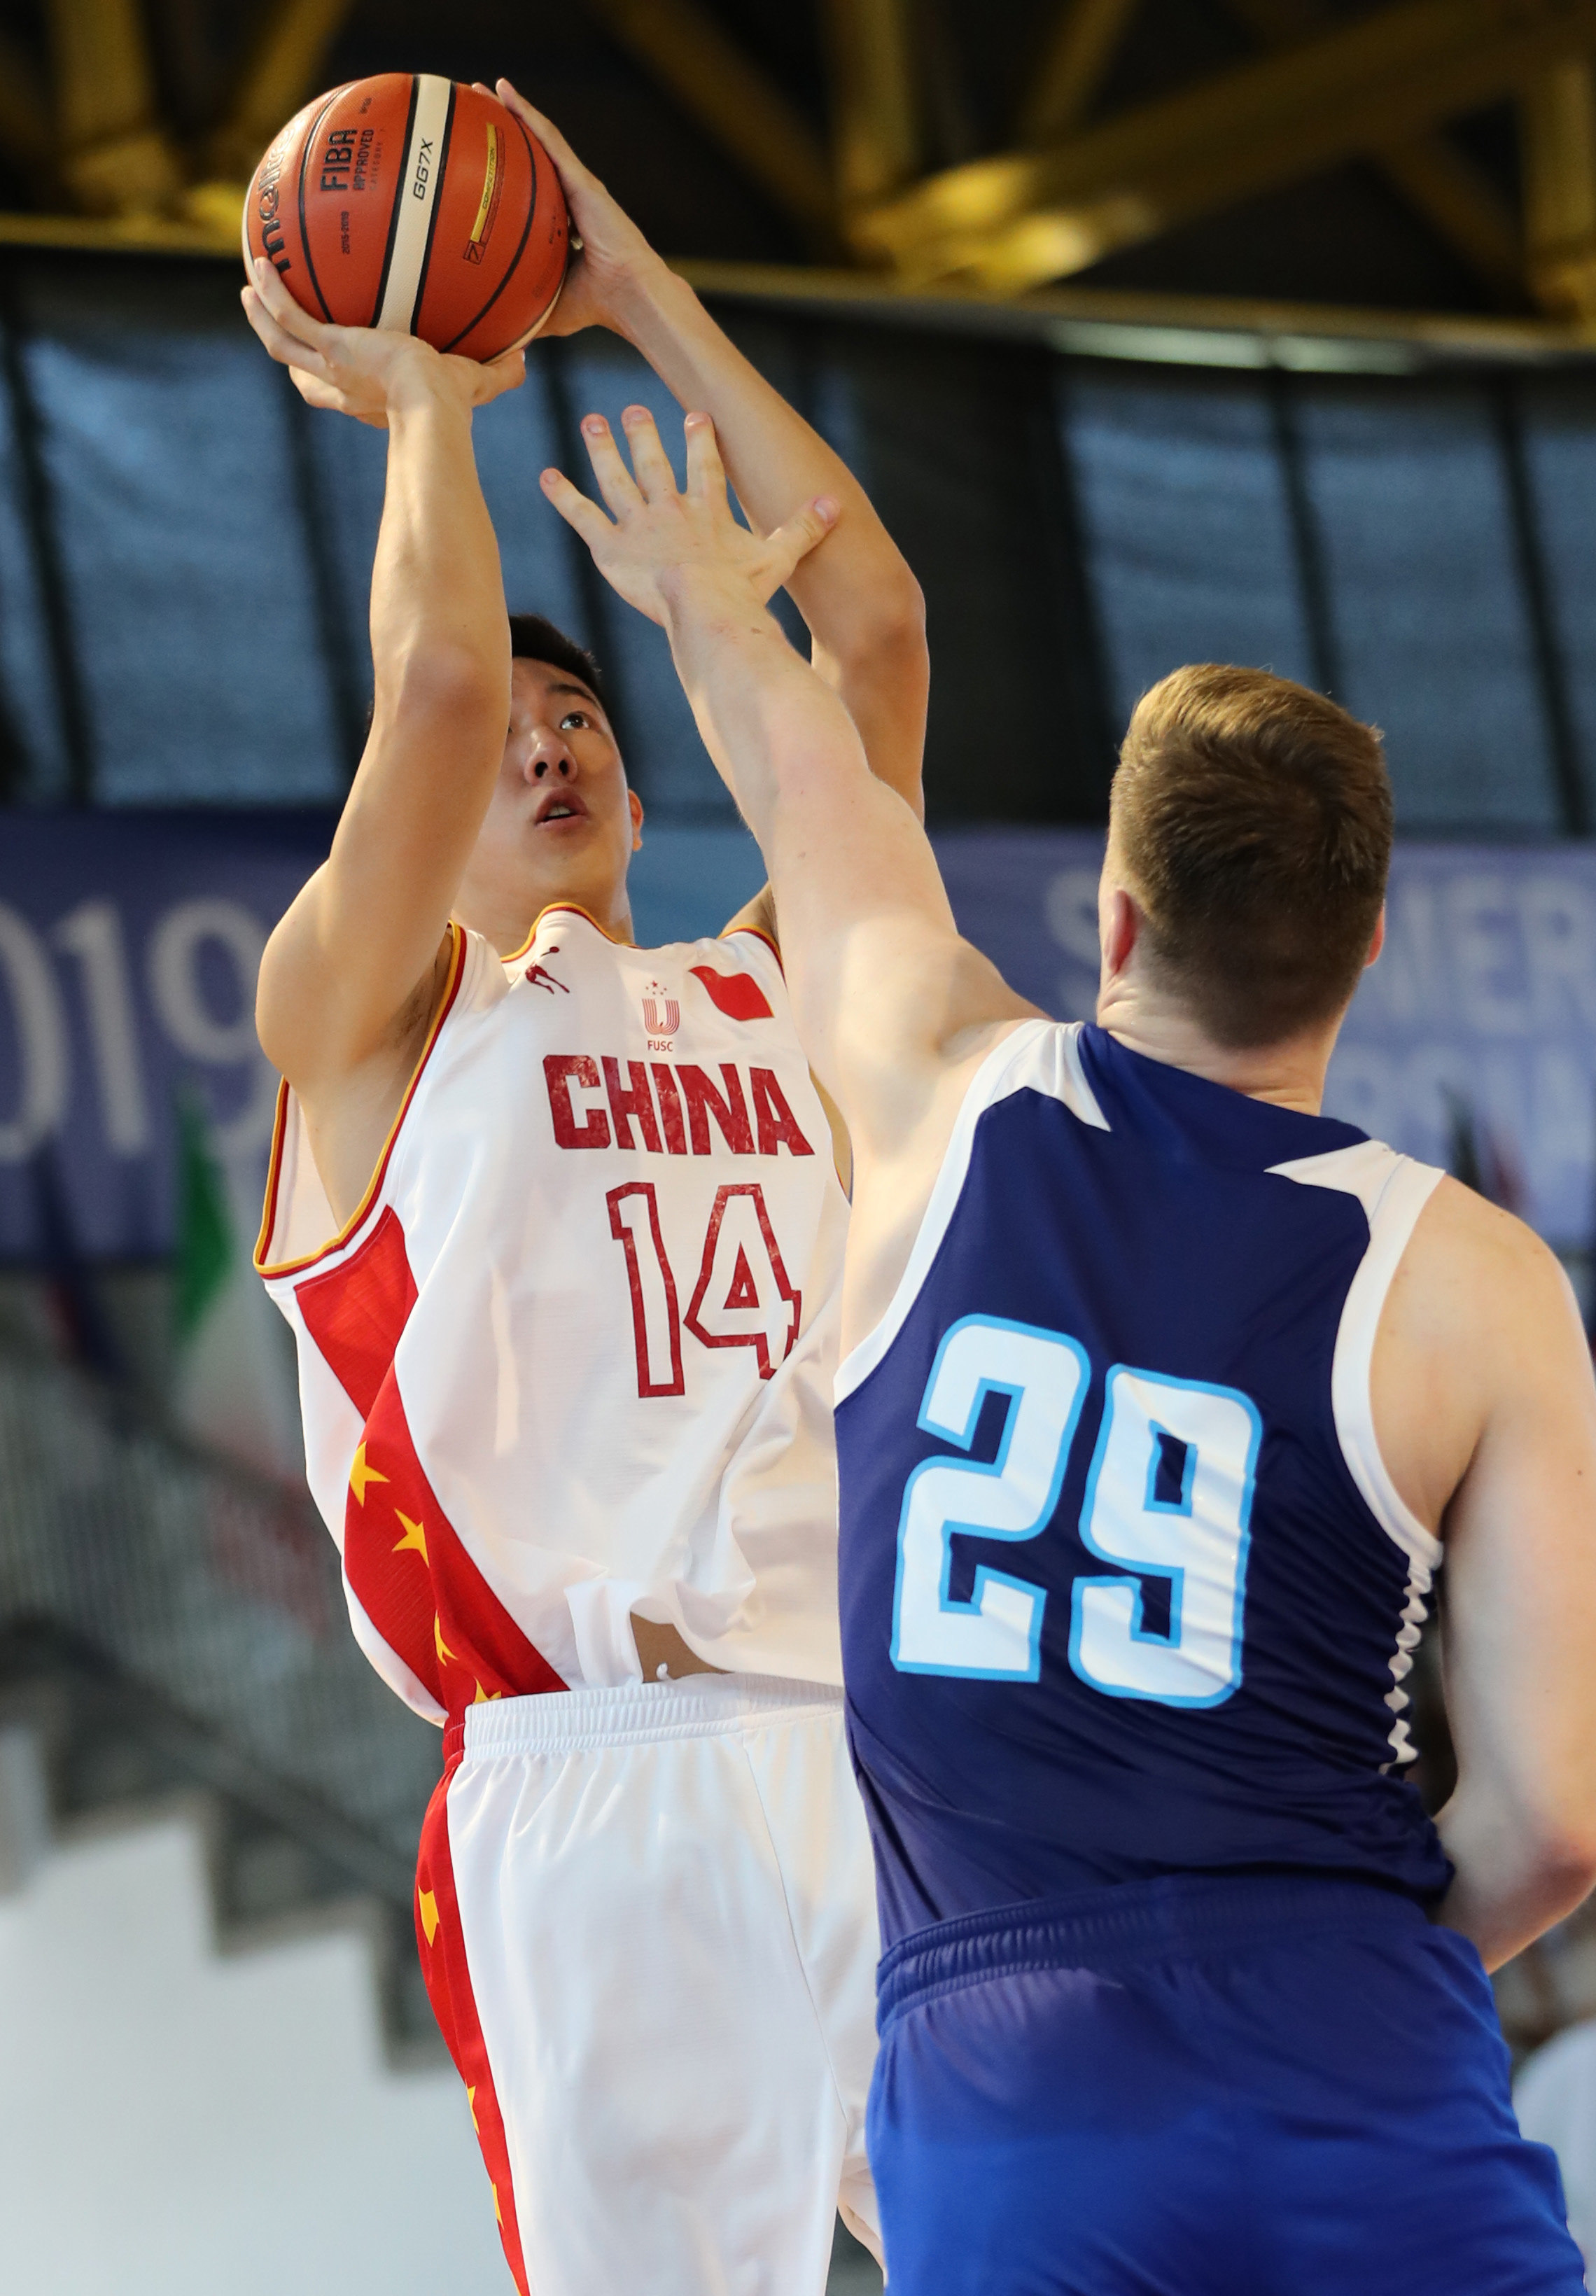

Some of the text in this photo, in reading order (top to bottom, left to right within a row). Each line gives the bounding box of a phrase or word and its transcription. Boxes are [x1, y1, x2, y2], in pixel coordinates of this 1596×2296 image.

[320, 129, 358, 191] FIBA
[353, 129, 374, 190] APPROVED
[413, 138, 433, 201] GG7X
[482, 147, 496, 209] COMPETITION
[258, 115, 302, 272] molte
[648, 1040, 673, 1052] FUSC
[542, 1054, 816, 1156] CHINA
[606, 1182, 802, 1399] 14
[890, 1313, 1263, 1709] 29
